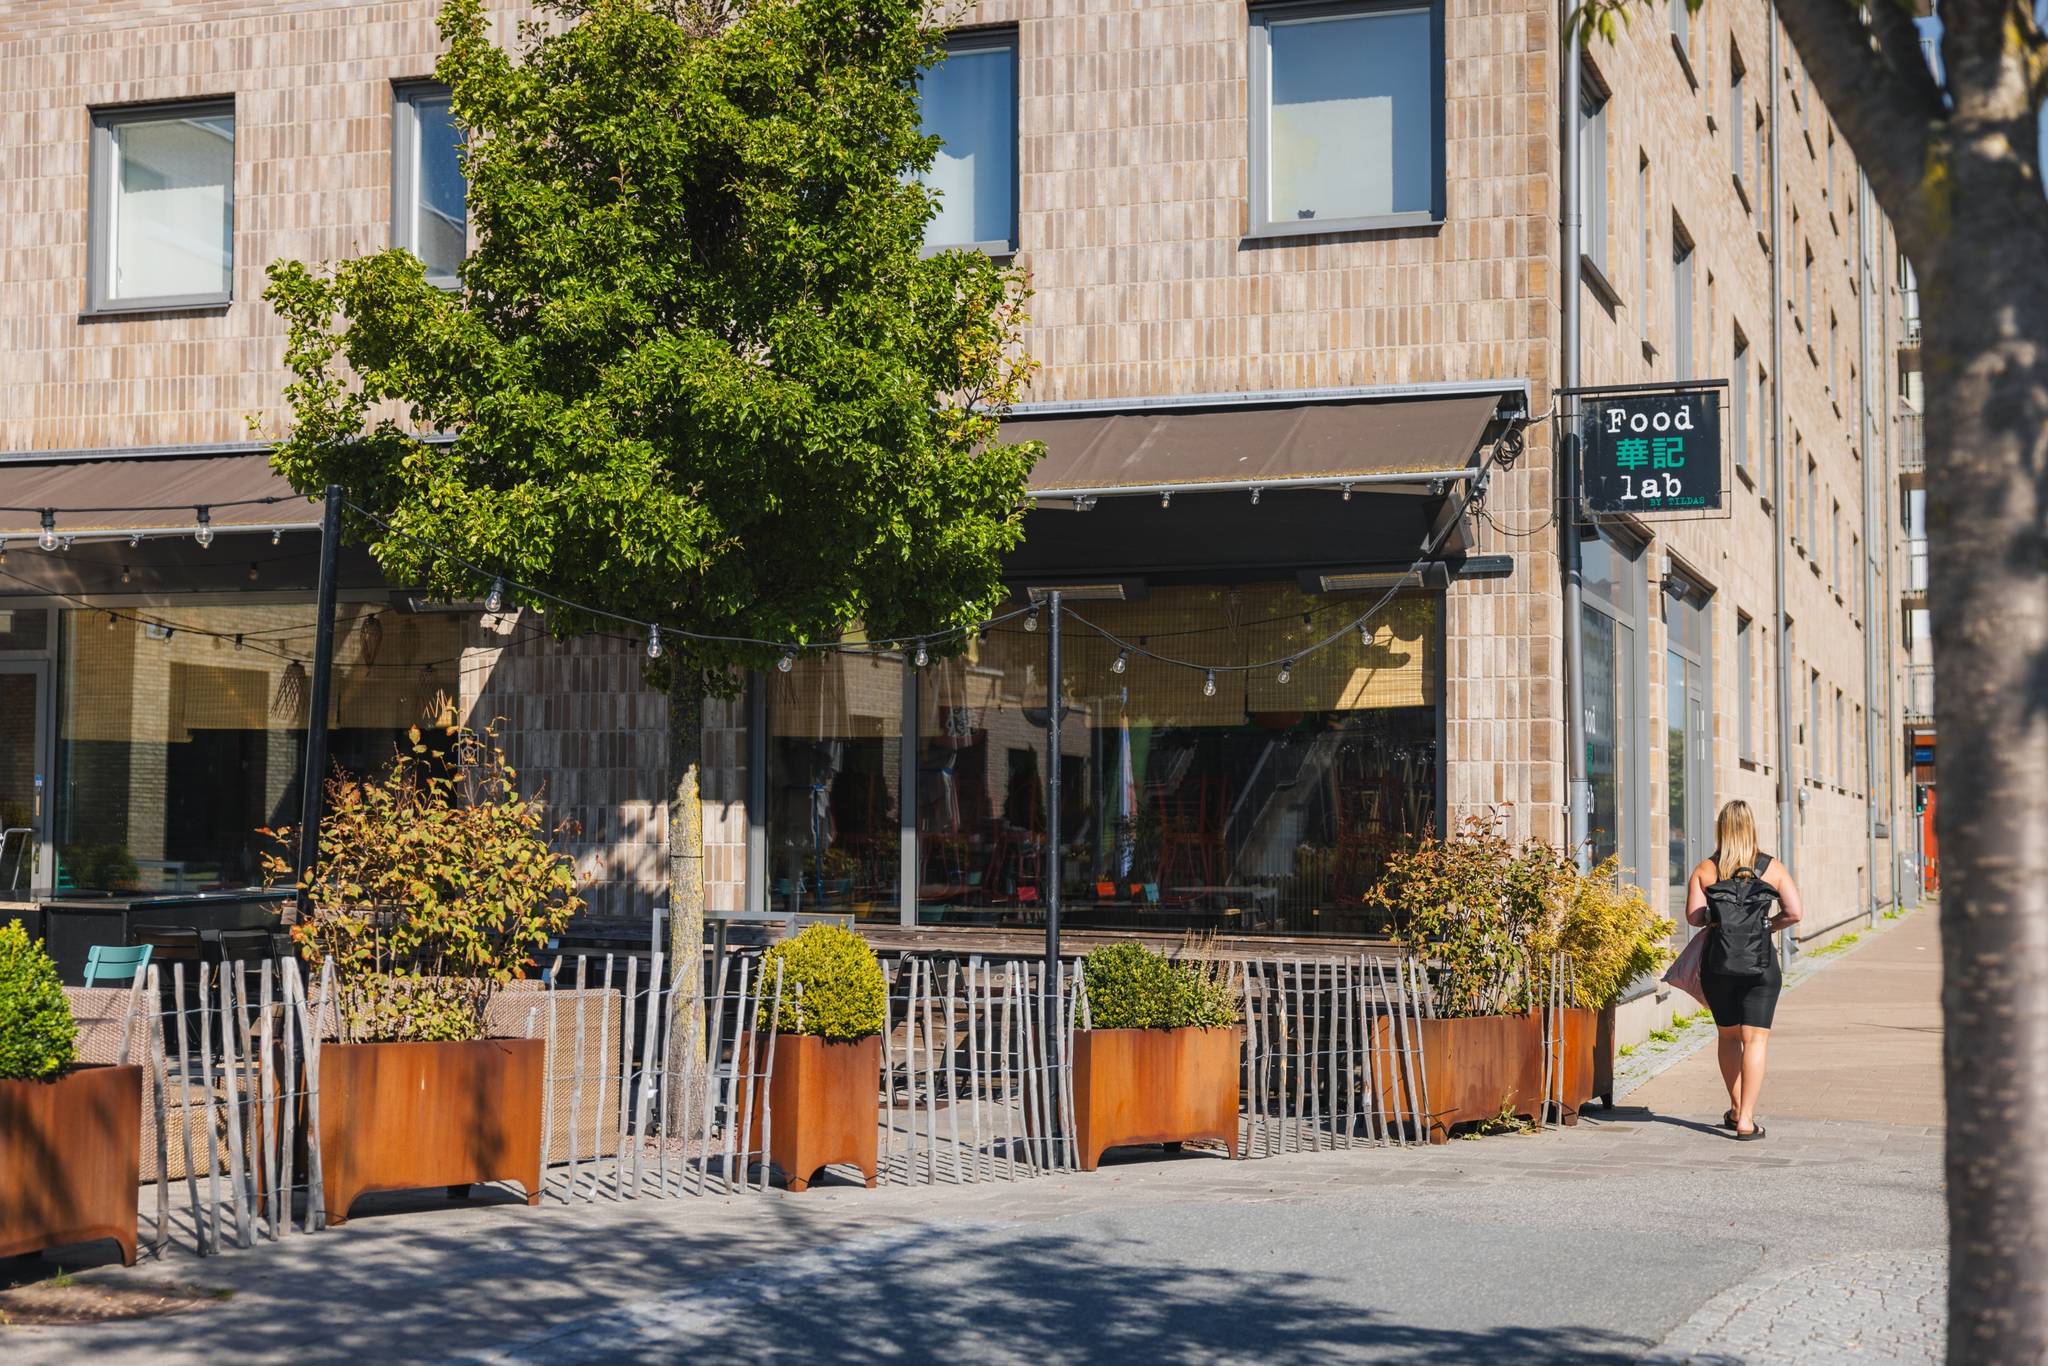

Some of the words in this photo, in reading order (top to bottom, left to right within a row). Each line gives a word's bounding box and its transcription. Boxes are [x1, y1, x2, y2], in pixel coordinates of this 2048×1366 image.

[1606, 405, 1694, 433] Food
[1616, 437, 1684, 470] 華記
[1620, 473, 1682, 499] lab
[1650, 498, 1662, 506] BY
